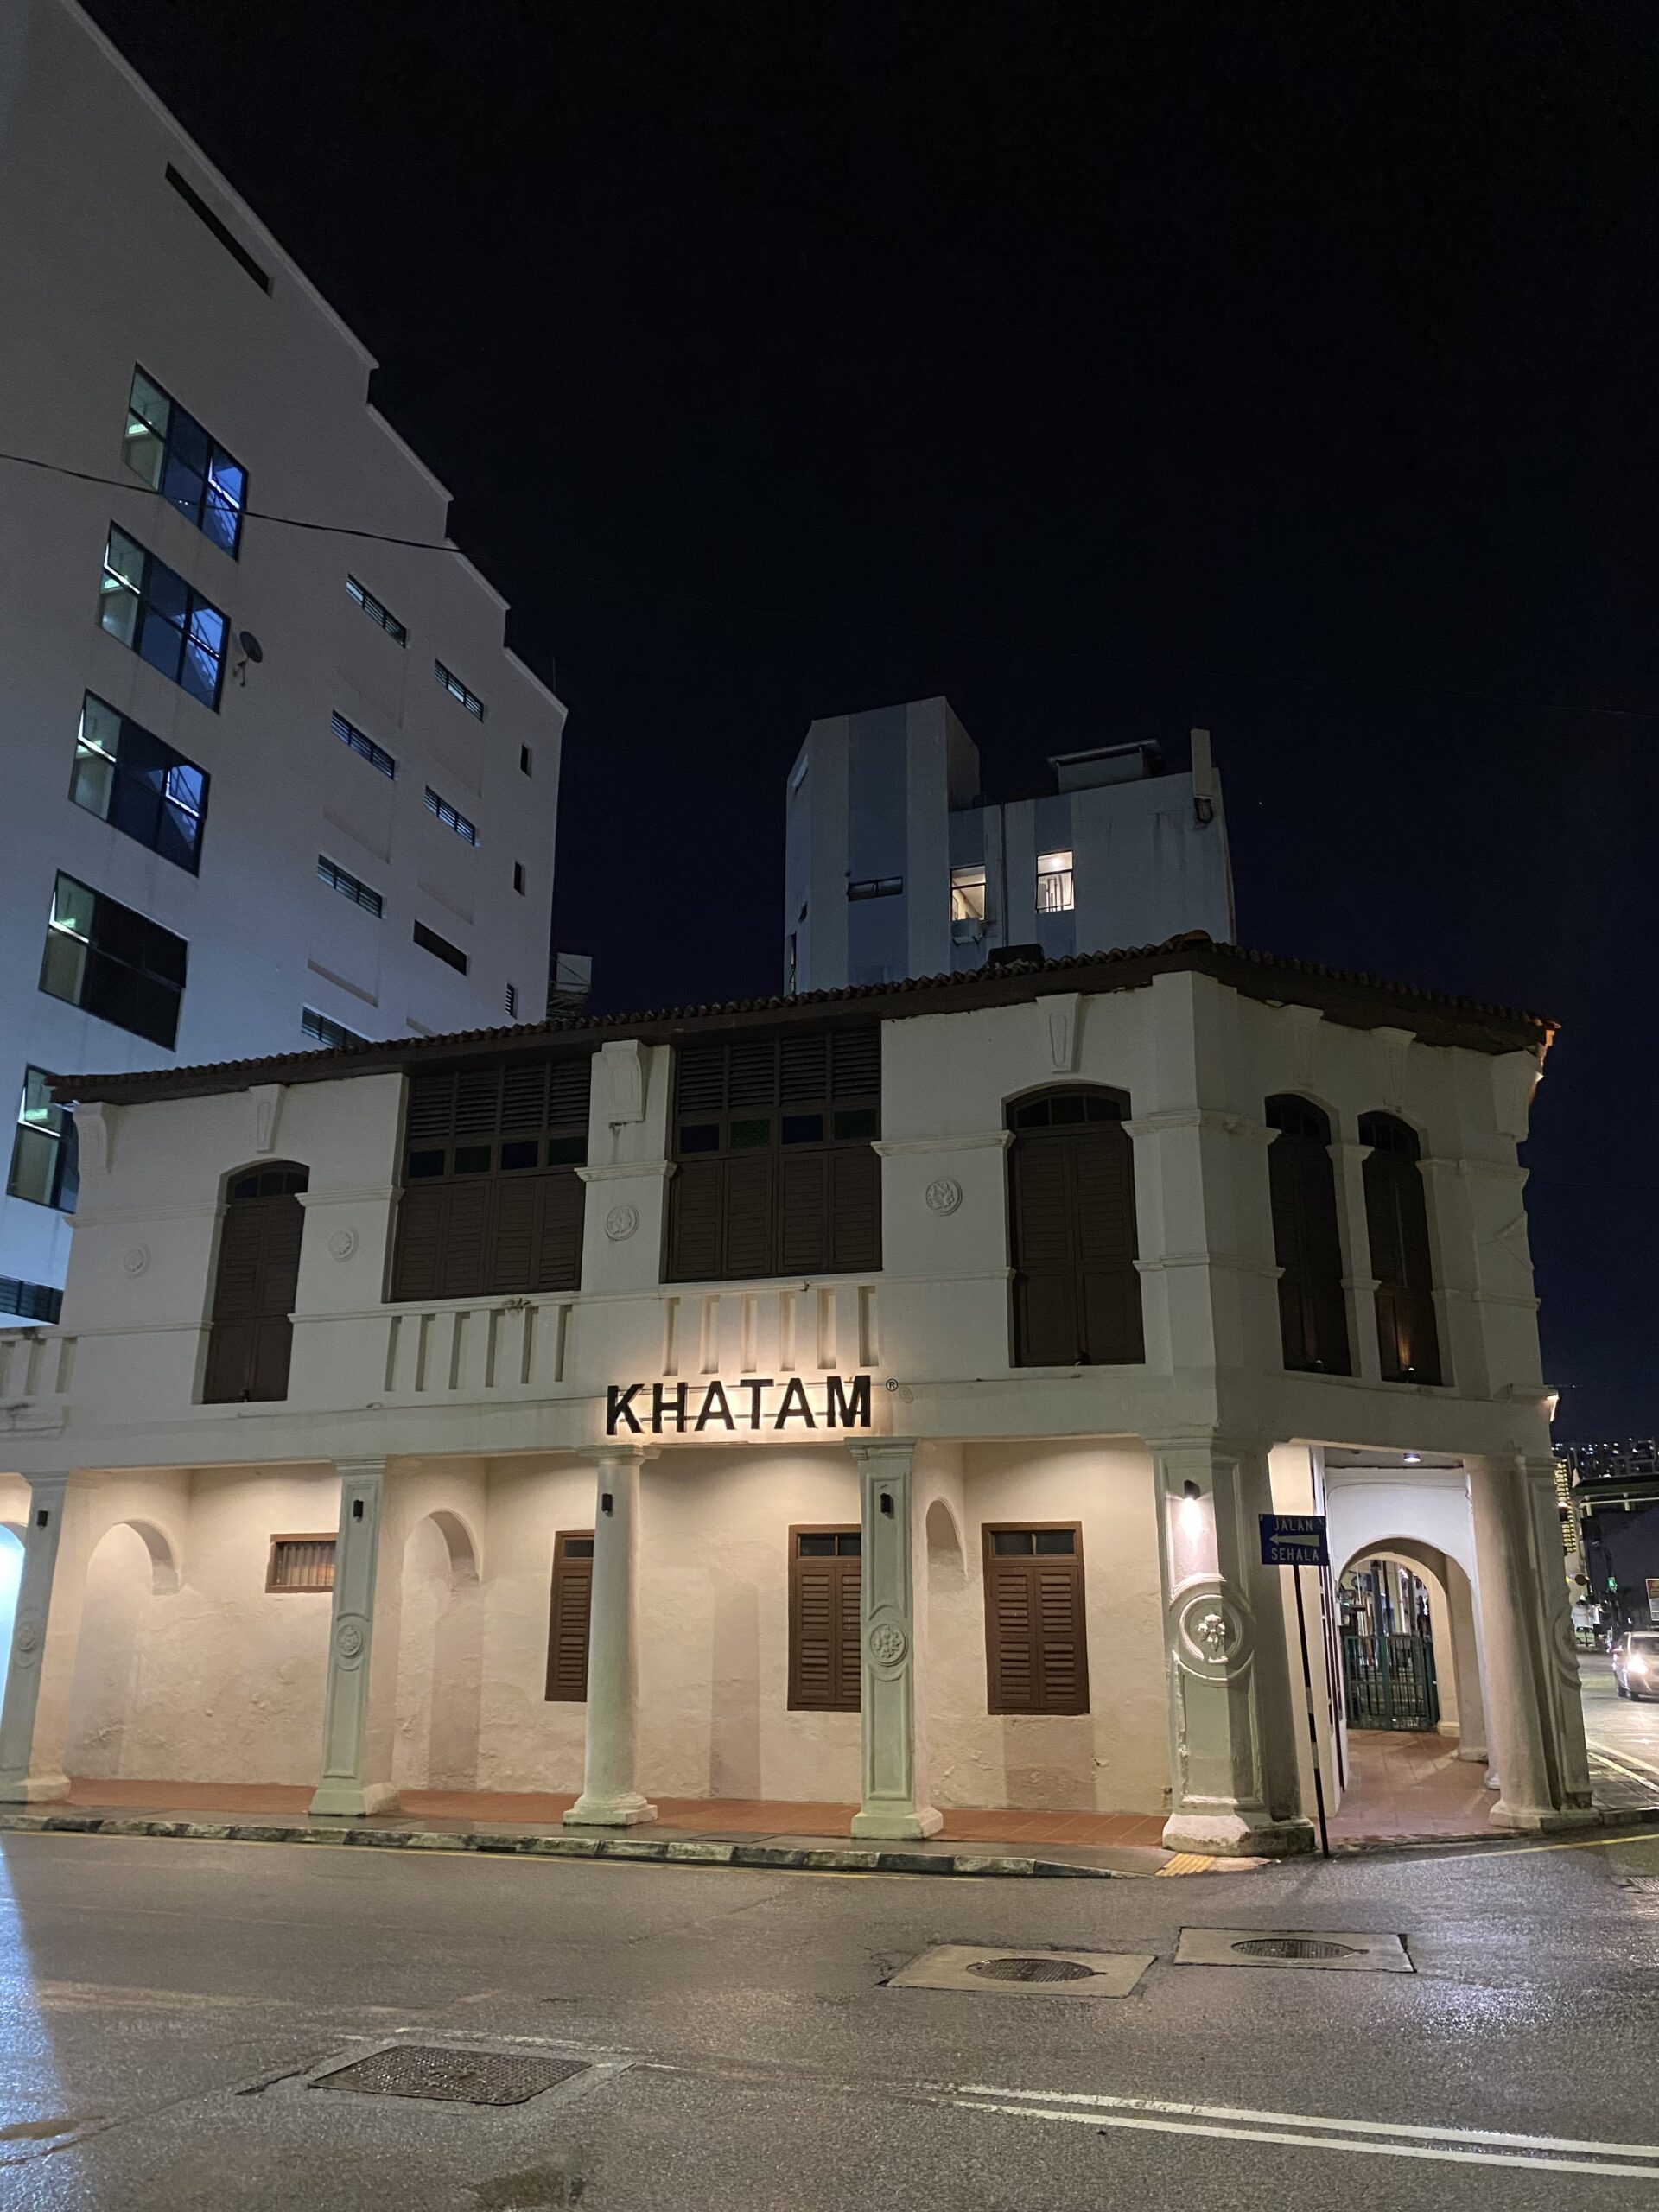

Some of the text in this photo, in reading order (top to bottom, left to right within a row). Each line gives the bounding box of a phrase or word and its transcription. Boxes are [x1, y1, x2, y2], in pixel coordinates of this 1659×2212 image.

[607, 1375, 871, 1435] KHATAM
[1274, 1517, 1313, 1531] JALAN
[1271, 1548, 1319, 1561] SEHALA
